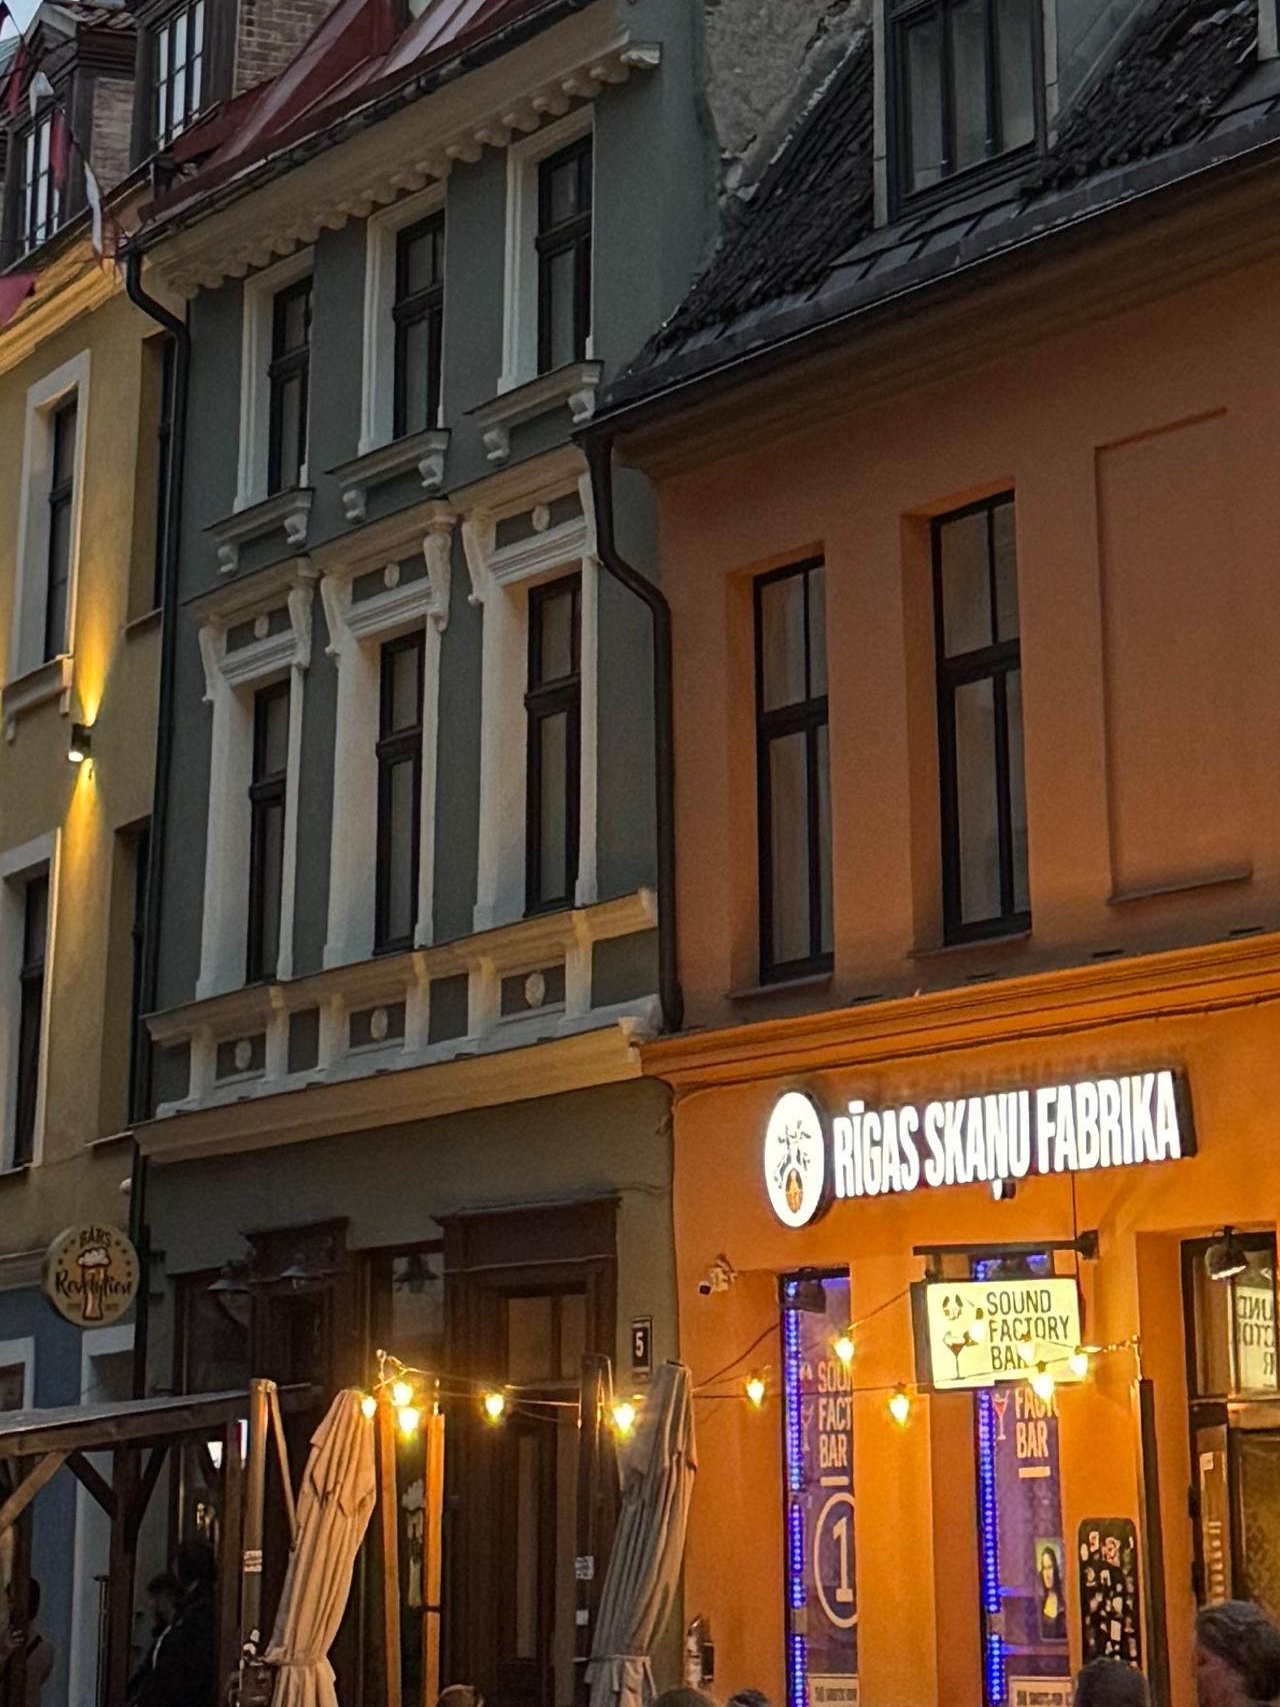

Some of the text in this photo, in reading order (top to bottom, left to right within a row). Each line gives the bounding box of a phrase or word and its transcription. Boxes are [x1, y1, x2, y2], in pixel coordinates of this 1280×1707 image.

[832, 1071, 1181, 1201] RĪGAS SKAŅU FABRIKA
[986, 1289, 1052, 1316] SOUND
[635, 1331, 644, 1358] 5
[988, 1315, 1070, 1343] FACTORY
[820, 1434, 848, 1468] BAR
[1016, 1420, 1049, 1459] BAR
[832, 1516, 853, 1603] 1
